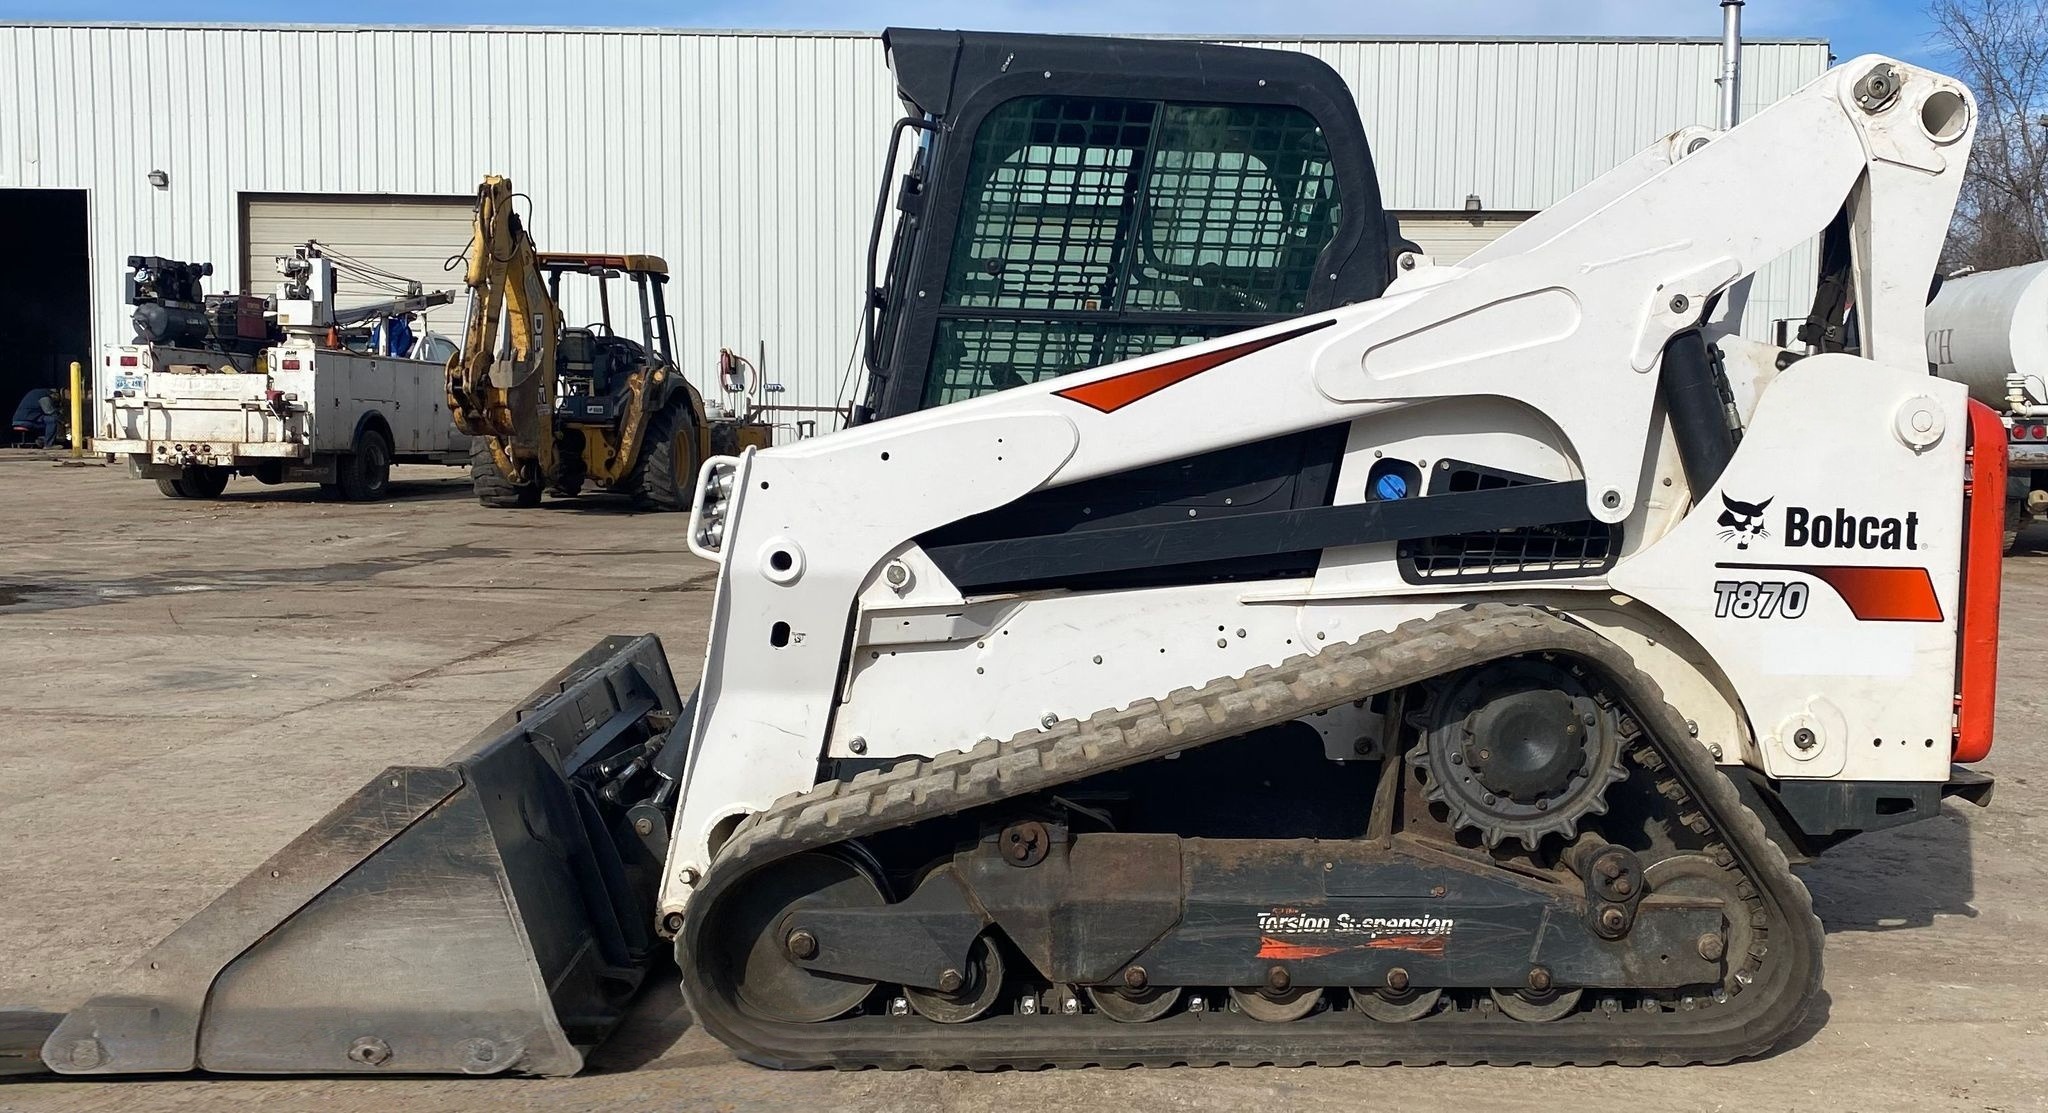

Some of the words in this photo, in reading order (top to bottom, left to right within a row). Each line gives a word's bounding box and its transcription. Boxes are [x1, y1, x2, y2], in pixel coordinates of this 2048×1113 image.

[1785, 507, 1918, 550] Bobcat
[1714, 581, 1809, 620] T870
[1257, 913, 1330, 933] Torsion
